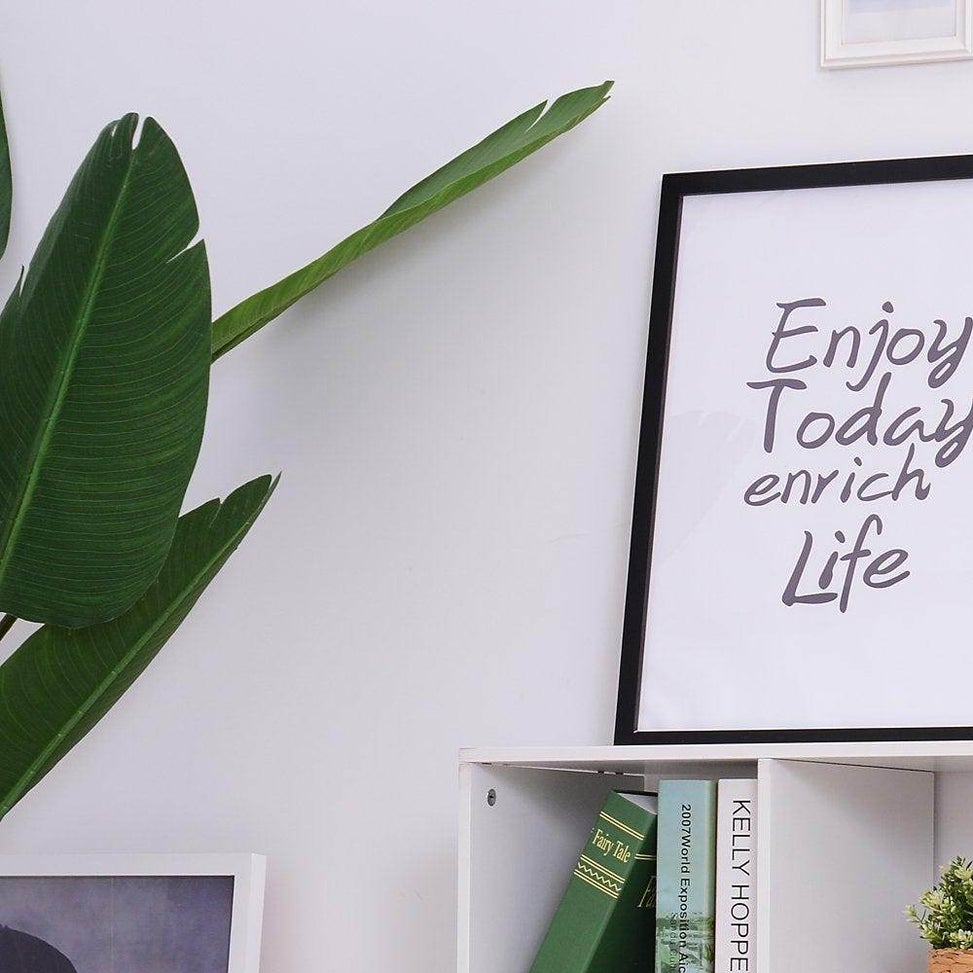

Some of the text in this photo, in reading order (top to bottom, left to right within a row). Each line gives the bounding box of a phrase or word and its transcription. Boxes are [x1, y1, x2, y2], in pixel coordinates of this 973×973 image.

[766, 298, 973, 391] Enjoy
[744, 443, 931, 506] enrich
[782, 514, 910, 613] Life
[592, 829, 630, 863] Fairy Tale
[731, 799, 751, 877] KELLY
[677, 878, 691, 948] Exposition
